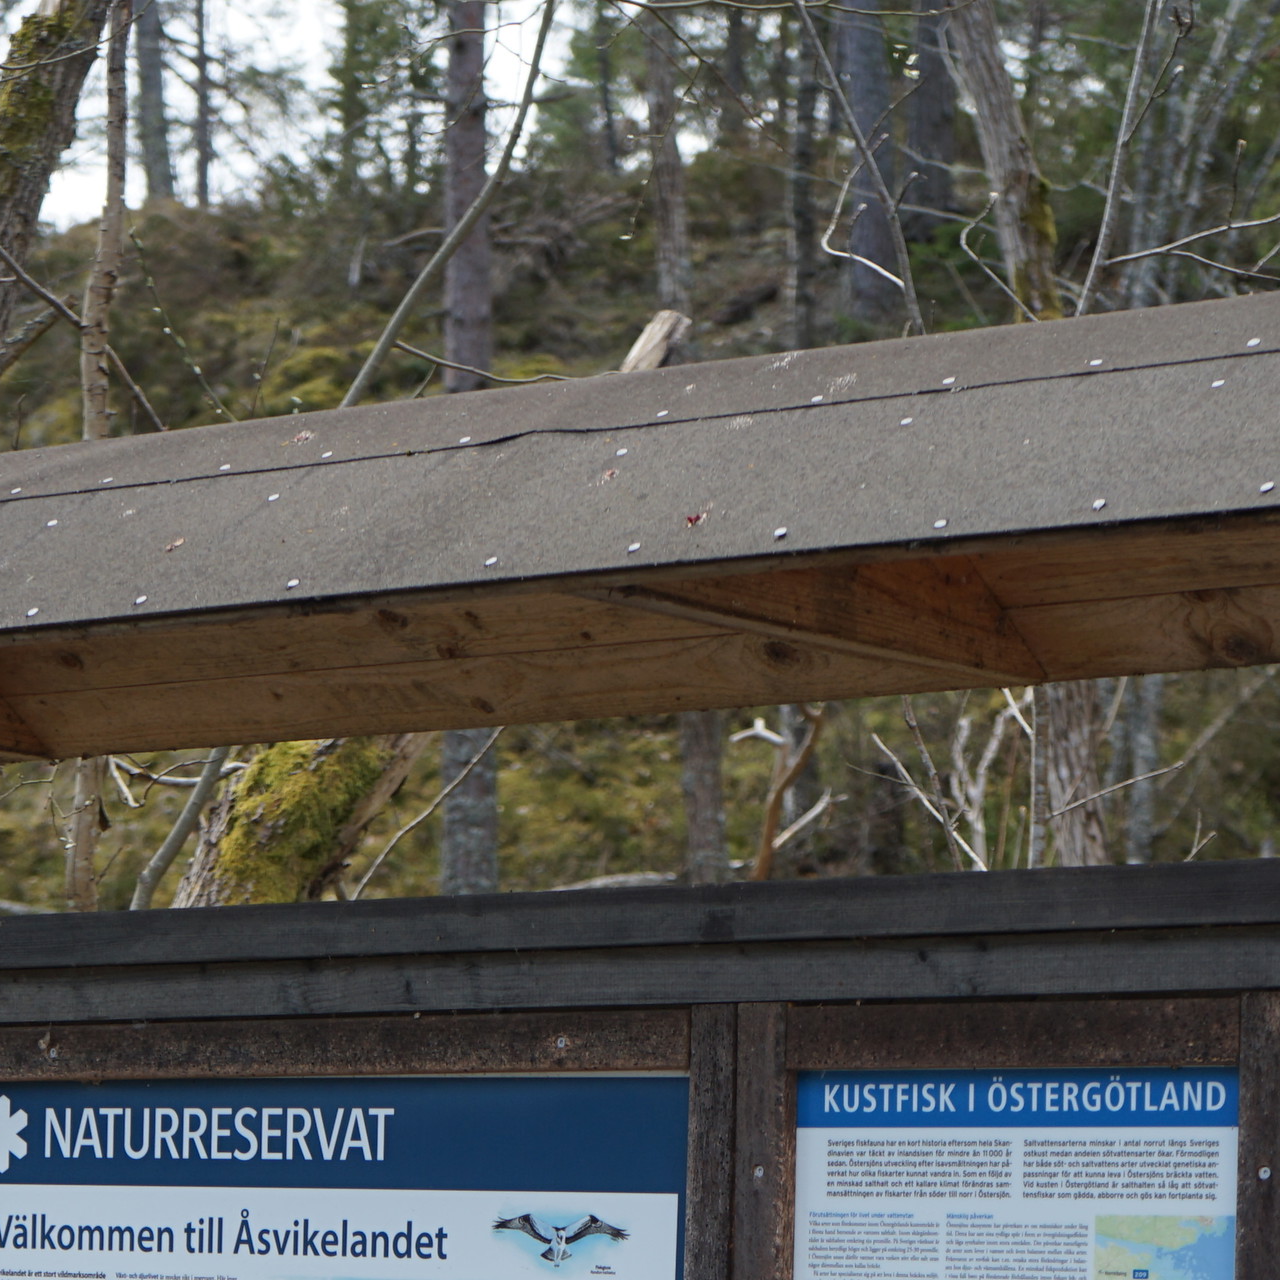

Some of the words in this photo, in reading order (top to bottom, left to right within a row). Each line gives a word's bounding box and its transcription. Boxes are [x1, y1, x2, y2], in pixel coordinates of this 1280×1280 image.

[824, 1082, 957, 1113] KUSTFISK
[968, 1083, 975, 1112] I
[988, 1076, 1227, 1112] ÖSTERGÖTLAND
[44, 1107, 395, 1161] NATURRESERVAT
[828, 1140, 855, 1149] Sveriges
[1168, 1140, 1187, 1149] längs
[1190, 1140, 1220, 1149] Sveriges
[1102, 1150, 1155, 1158] sötvattensarter
[1157, 1150, 1175, 1158] ökar.
[1176, 1150, 1220, 1159] Förmodligen
[849, 1159, 883, 1169] Östersjöns
[884, 1160, 918, 1169] utveckling
[989, 1160, 1000, 1168] har
[1001, 1160, 1013, 1169] på-
[1023, 1160, 1034, 1168] har
[1036, 1160, 1052, 1168] både
[1054, 1160, 1067, 1168] söt-
[1173, 1161, 1207, 1170] genetiska
[988, 1170, 1003, 1179] följd
[939, 1180, 960, 1188] klimat
[962, 1180, 994, 1188] förändras
[827, 1190, 874, 1199] mansättningen
[884, 1190, 912, 1198] fiskarter
[914, 1190, 928, 1198] från
[978, 1190, 1012, 1200] Östersjön.
[184, 1216, 224, 1254] till
[233, 1209, 449, 1260] Åsvikelandet
[58, 1271, 106, 1279] vildmarksområde
